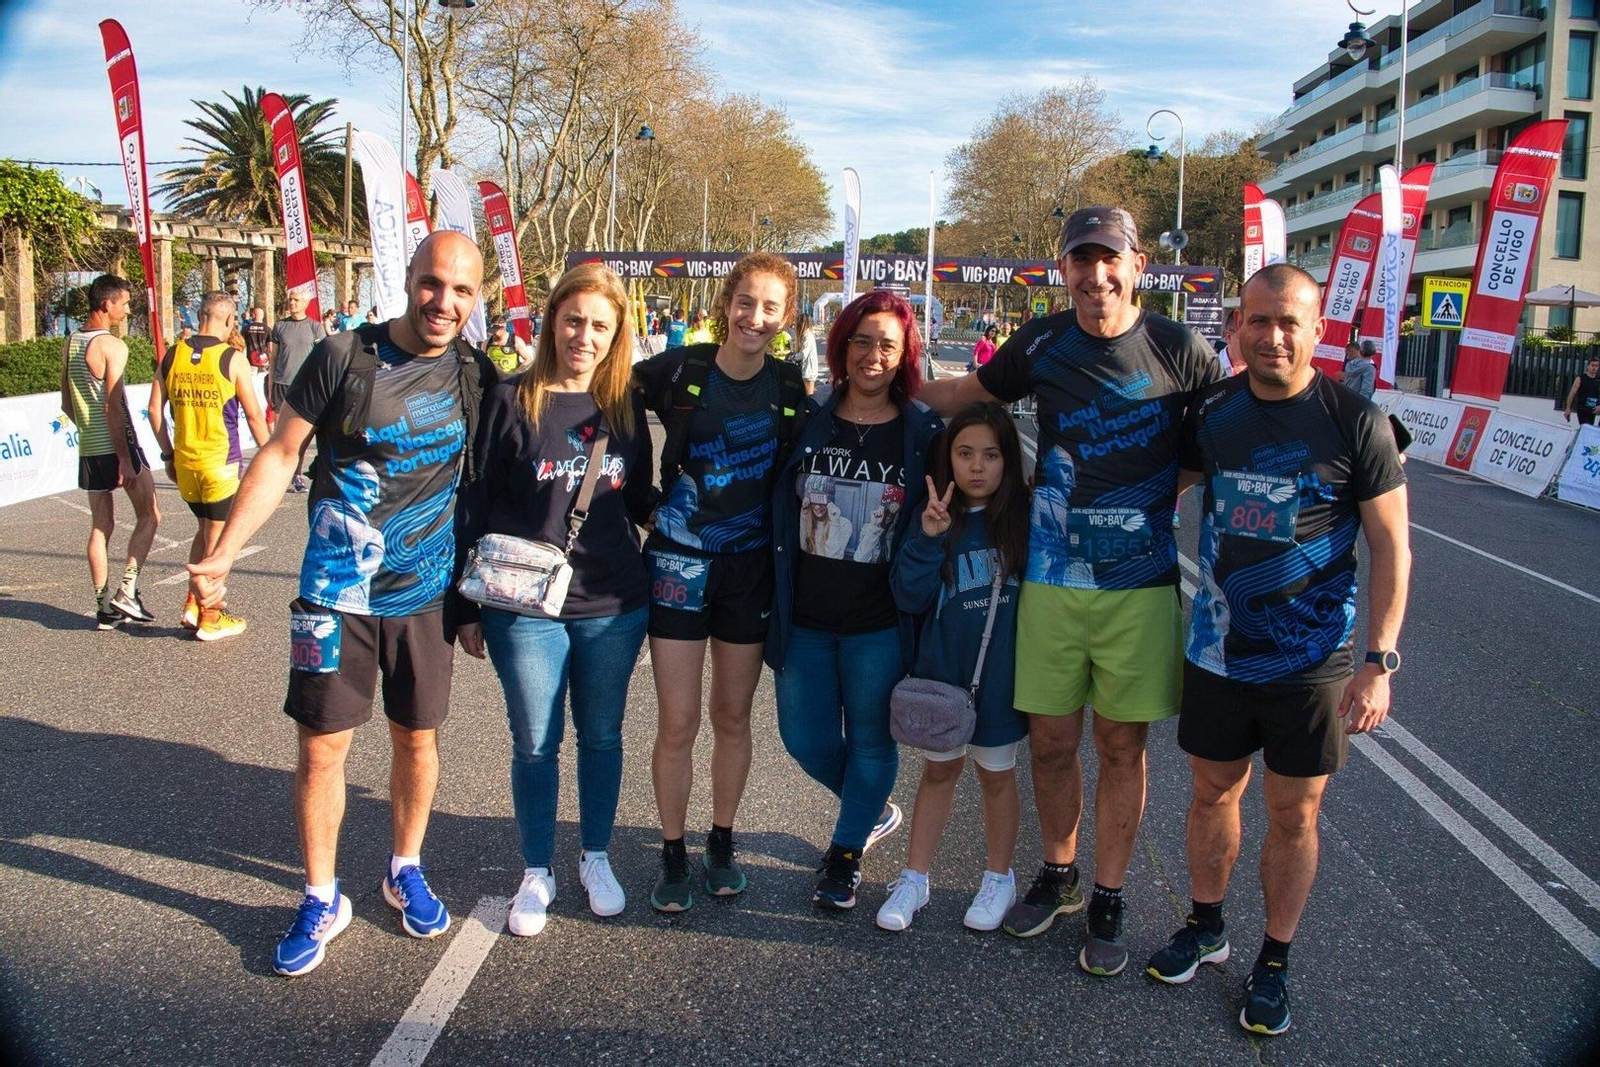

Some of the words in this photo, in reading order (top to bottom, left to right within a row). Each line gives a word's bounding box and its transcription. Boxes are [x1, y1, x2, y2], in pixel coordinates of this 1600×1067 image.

[1487, 219, 1513, 290] CONCELLO
[1508, 229, 1525, 262] VIGO
[1331, 262, 1353, 316] CONCELLO
[1347, 271, 1361, 299] VIGO
[1502, 267, 1517, 285] DE
[1342, 298, 1353, 313] DE
[412, 397, 453, 418] maratona
[1058, 398, 1101, 432] Aqui
[1087, 399, 1163, 440] Nasceu
[1401, 408, 1449, 430] CONCELLO
[365, 415, 410, 446] Aqui
[396, 419, 464, 454] Nasceu
[1077, 415, 1162, 461] Portugal
[1413, 430, 1437, 446] VIGO
[1492, 428, 1553, 458] CONCELLO
[690, 434, 726, 459] Aqui
[713, 437, 778, 470] Nasceu
[822, 447, 852, 457] WORK
[1255, 447, 1275, 460] meia
[1256, 448, 1308, 470] maratona
[798, 455, 906, 487] ALWAYS
[1489, 448, 1505, 466] DE
[1509, 453, 1537, 476] VIGO
[1230, 505, 1277, 533] 804
[1083, 538, 1142, 559] 1355
[653, 580, 687, 604] 806
